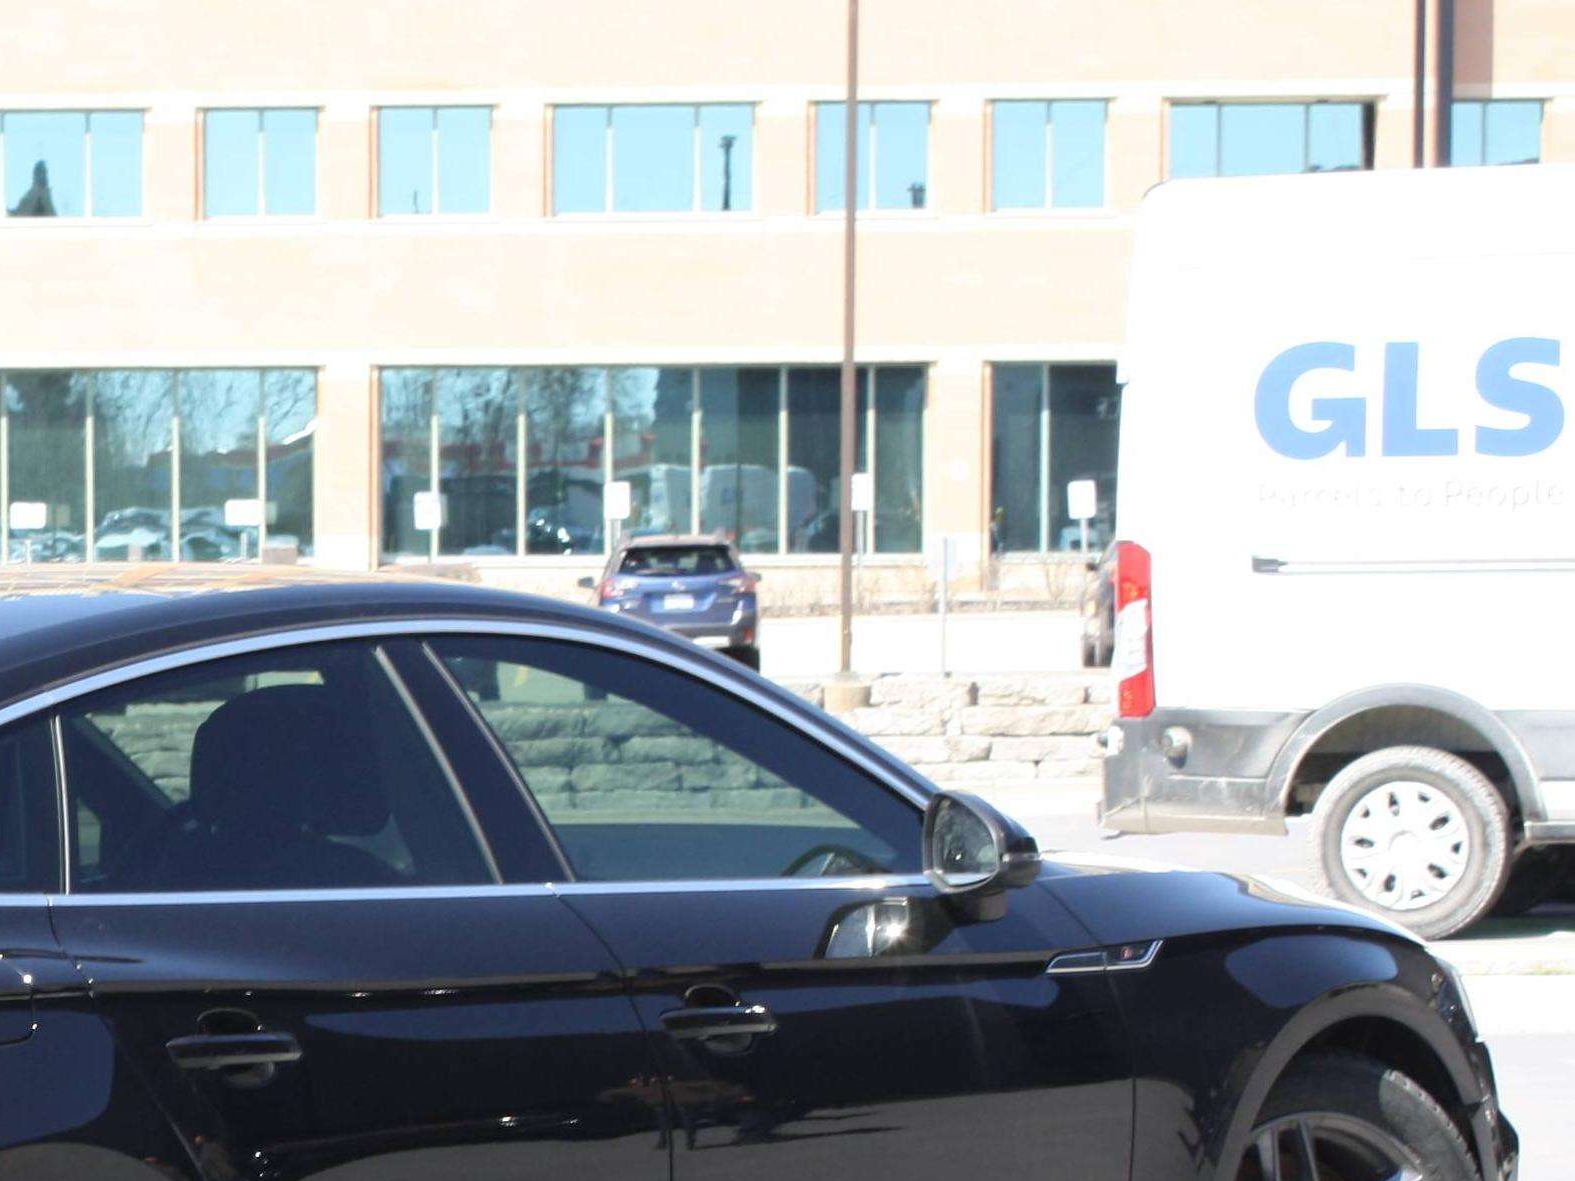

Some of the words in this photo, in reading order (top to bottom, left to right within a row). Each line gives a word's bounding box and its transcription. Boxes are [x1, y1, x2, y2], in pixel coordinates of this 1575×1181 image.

[1254, 336, 1566, 461] GLS
[1395, 479, 1432, 507] to
[1444, 477, 1565, 511] People
